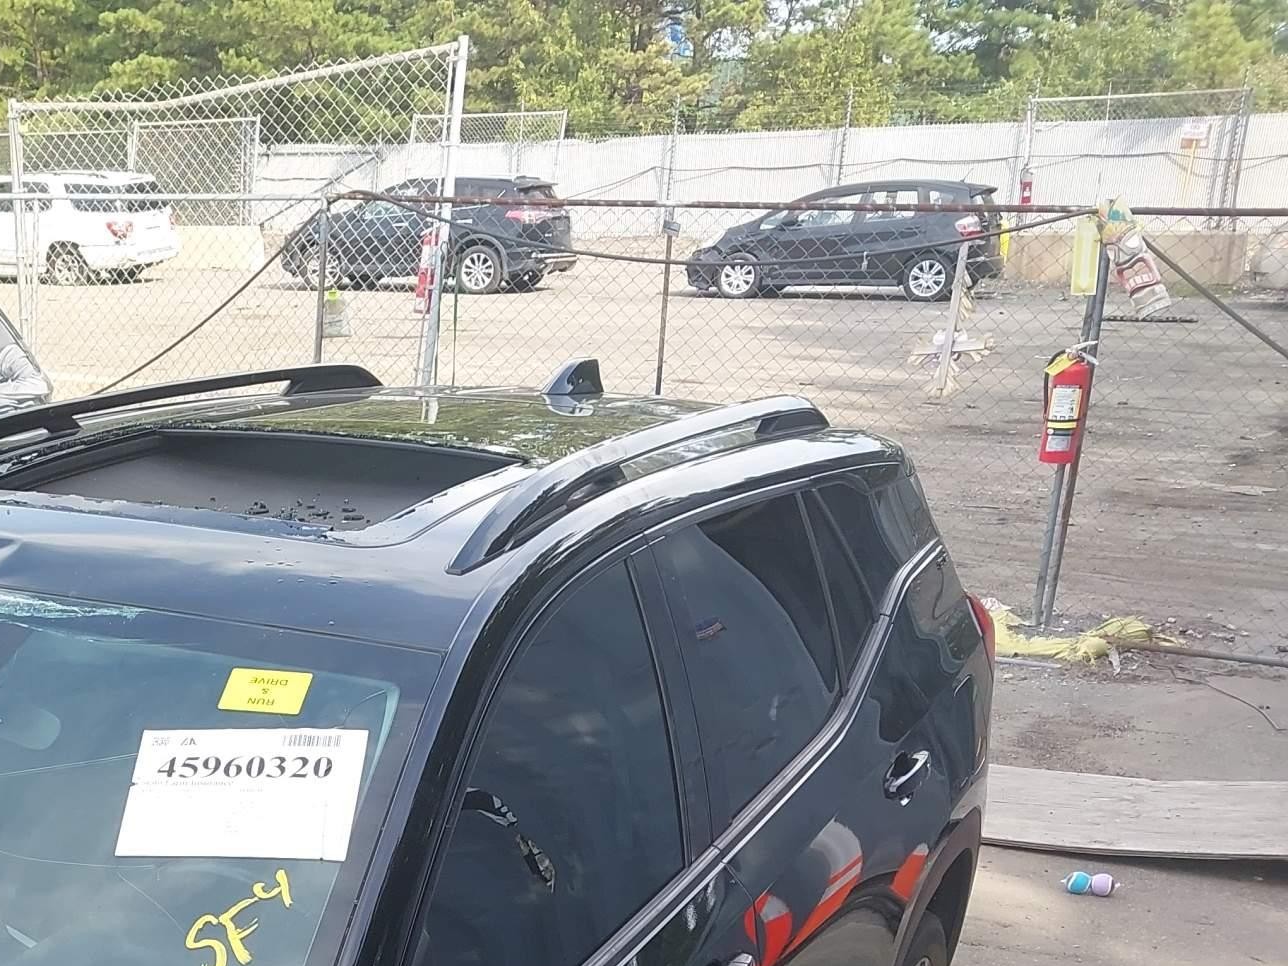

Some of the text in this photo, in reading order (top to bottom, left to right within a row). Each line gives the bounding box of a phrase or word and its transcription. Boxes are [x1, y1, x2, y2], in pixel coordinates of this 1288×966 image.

[250, 676, 289, 686] DRIVE
[247, 697, 275, 706] RUN
[157, 755, 333, 779] 45960320
